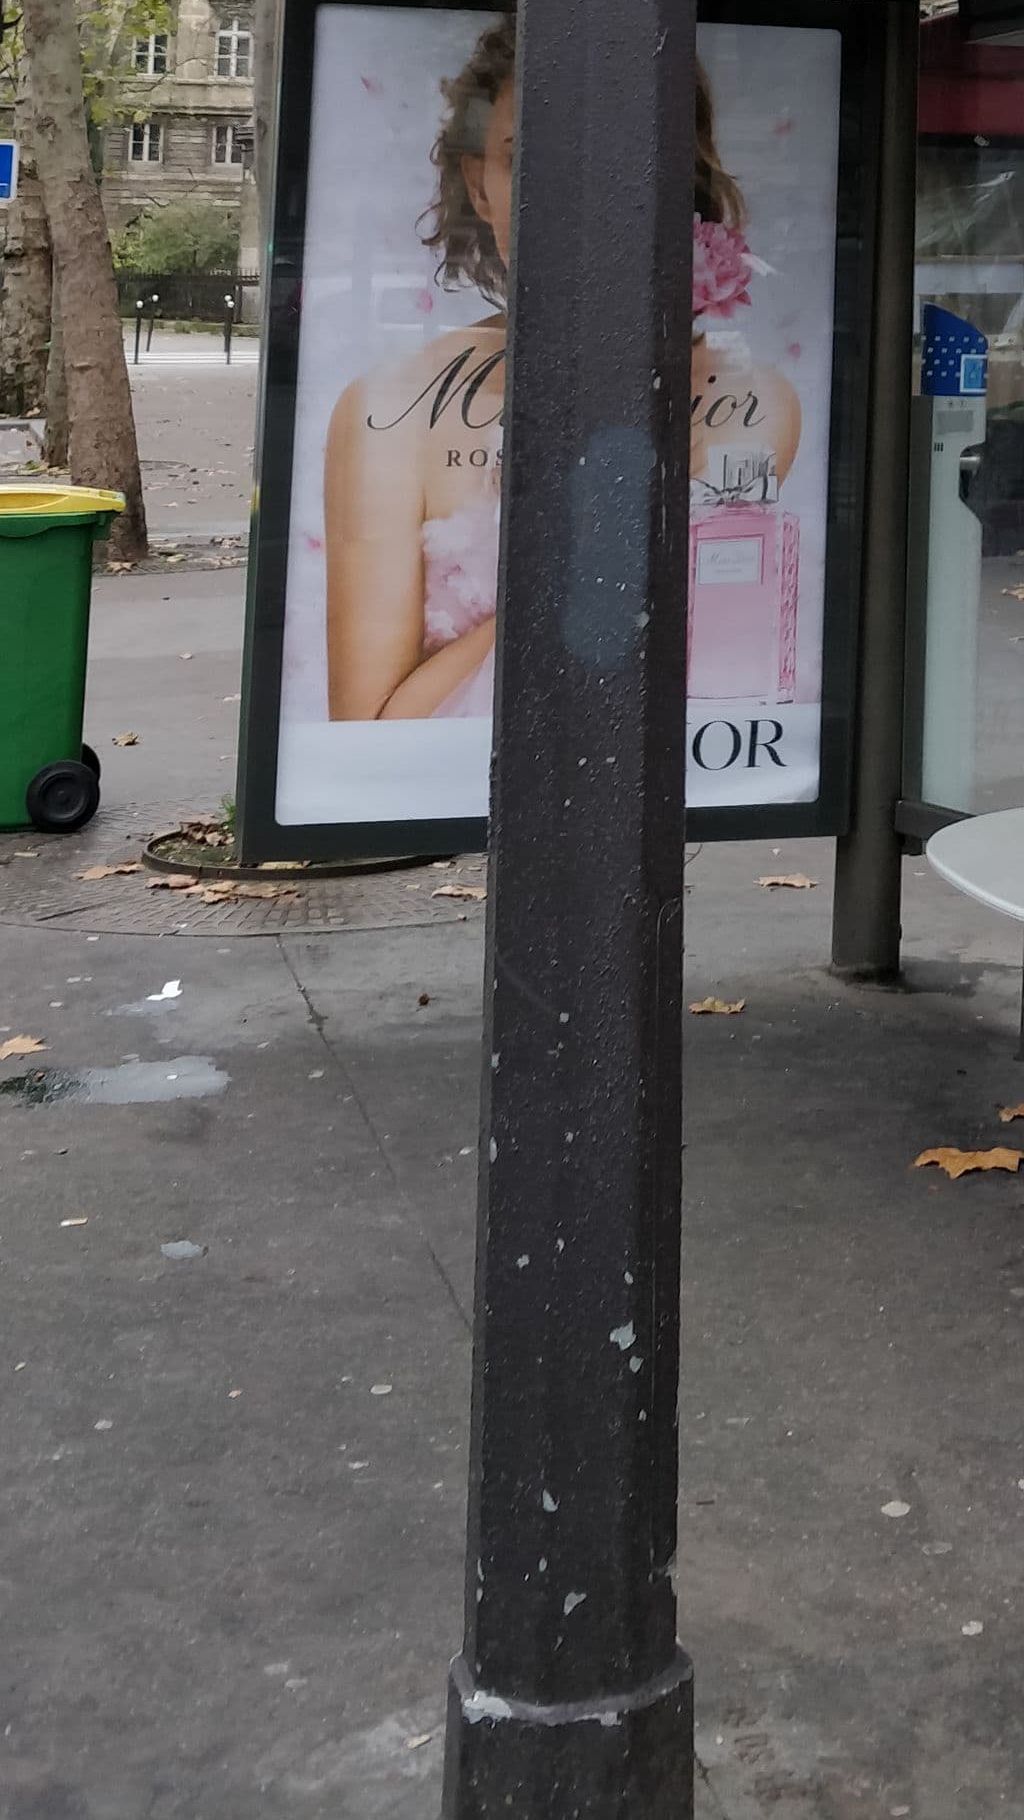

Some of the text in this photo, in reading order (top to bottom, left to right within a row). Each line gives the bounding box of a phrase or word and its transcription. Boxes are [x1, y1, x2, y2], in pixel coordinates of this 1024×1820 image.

[690, 374, 767, 428] ior
[446, 448, 504, 468] ROS
[688, 719, 789, 771] OR
